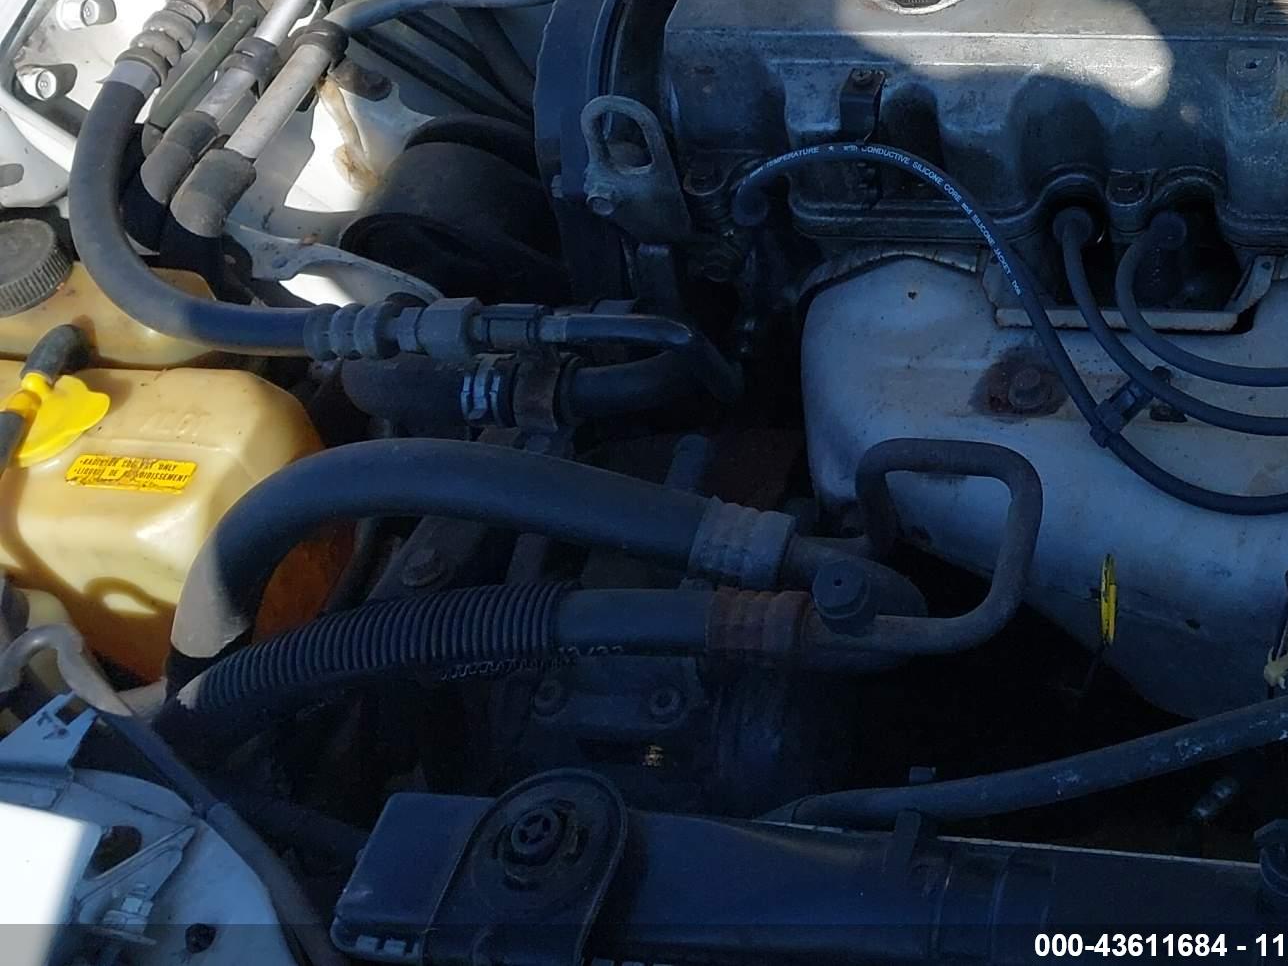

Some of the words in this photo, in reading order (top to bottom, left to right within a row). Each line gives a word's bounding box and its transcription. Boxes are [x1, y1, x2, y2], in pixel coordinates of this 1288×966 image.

[862, 146, 911, 165] CONDUCTIVE
[913, 161, 944, 185] SILICONE
[944, 184, 962, 202] CORE
[972, 214, 995, 245] SILICONE
[993, 248, 1011, 275] JACKET
